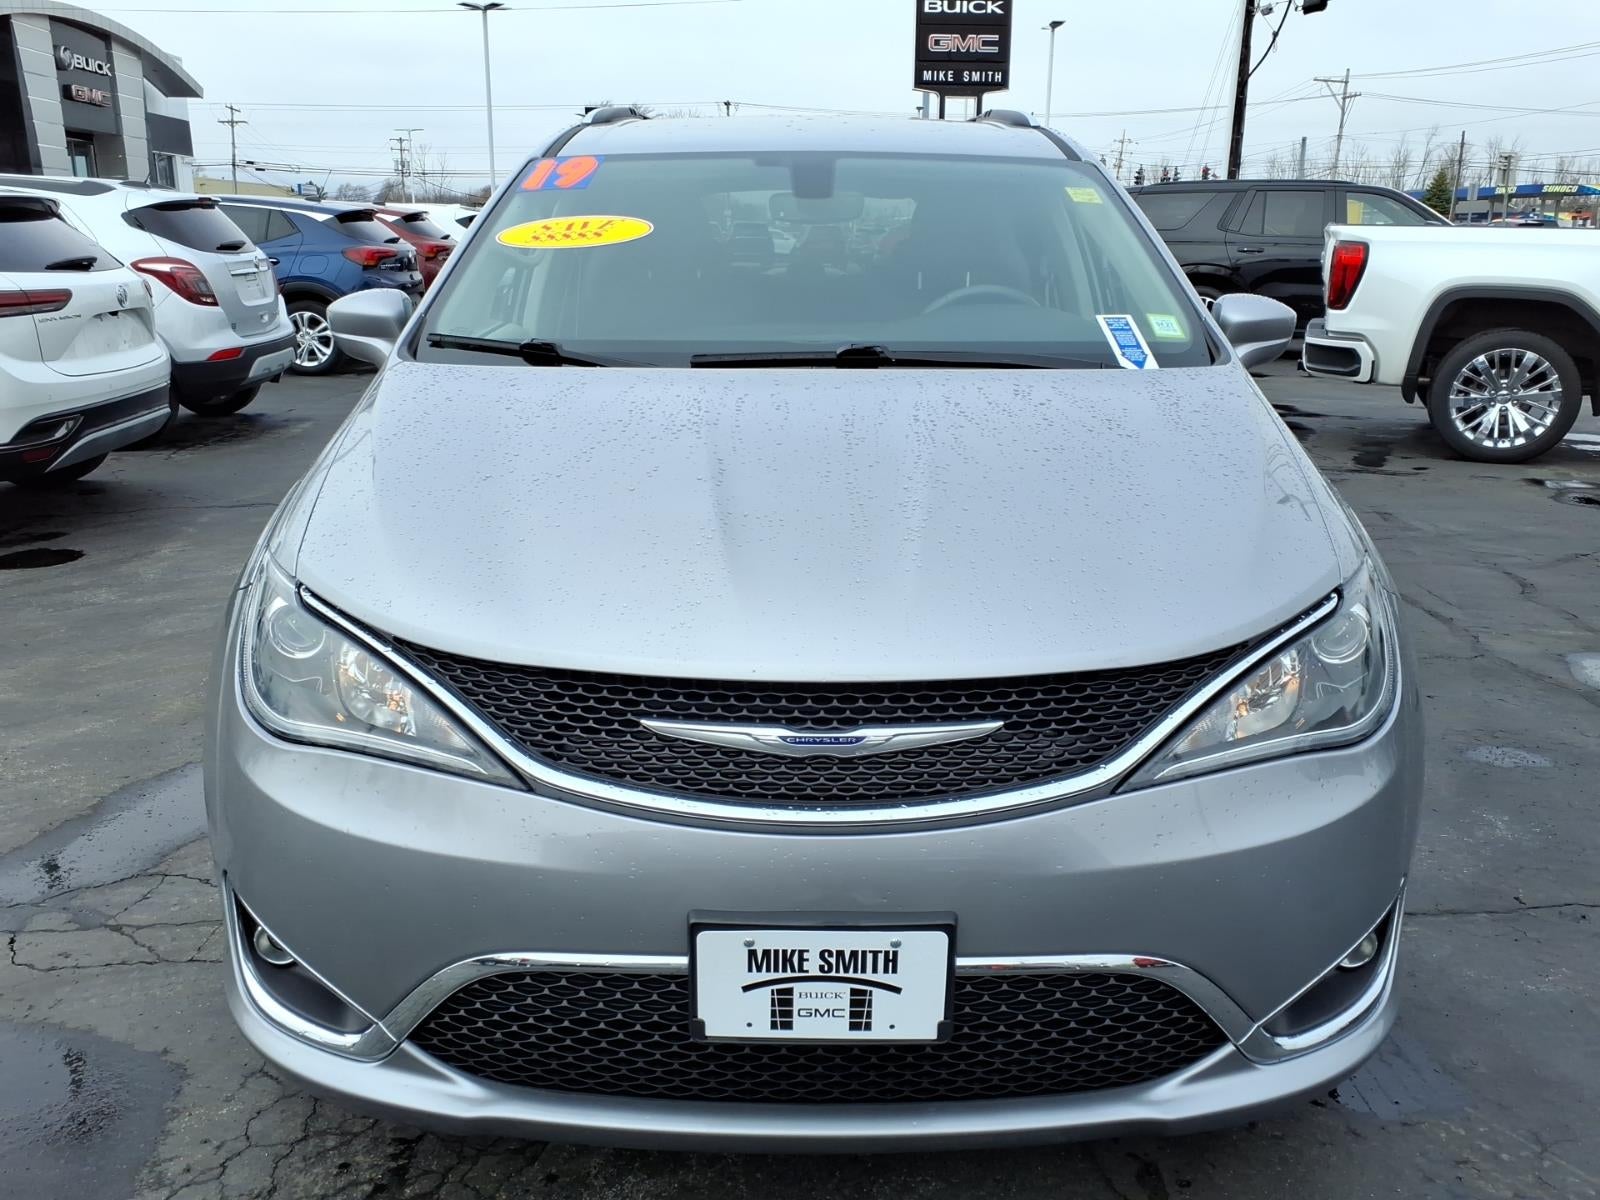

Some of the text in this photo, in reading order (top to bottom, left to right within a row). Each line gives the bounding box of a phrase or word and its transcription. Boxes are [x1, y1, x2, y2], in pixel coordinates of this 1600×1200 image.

[924, 0, 1004, 14] BUICK
[928, 34, 999, 53] GMC
[73, 53, 112, 77] BUICK
[923, 70, 1002, 83] MIKE SMITH
[71, 84, 111, 107] GMC
[521, 155, 599, 191] 19
[1541, 184, 1579, 193] SUNOCO
[747, 949, 899, 975] MIKE SMITH
[798, 991, 845, 1000] BUICK
[797, 1008, 846, 1018] GMC
